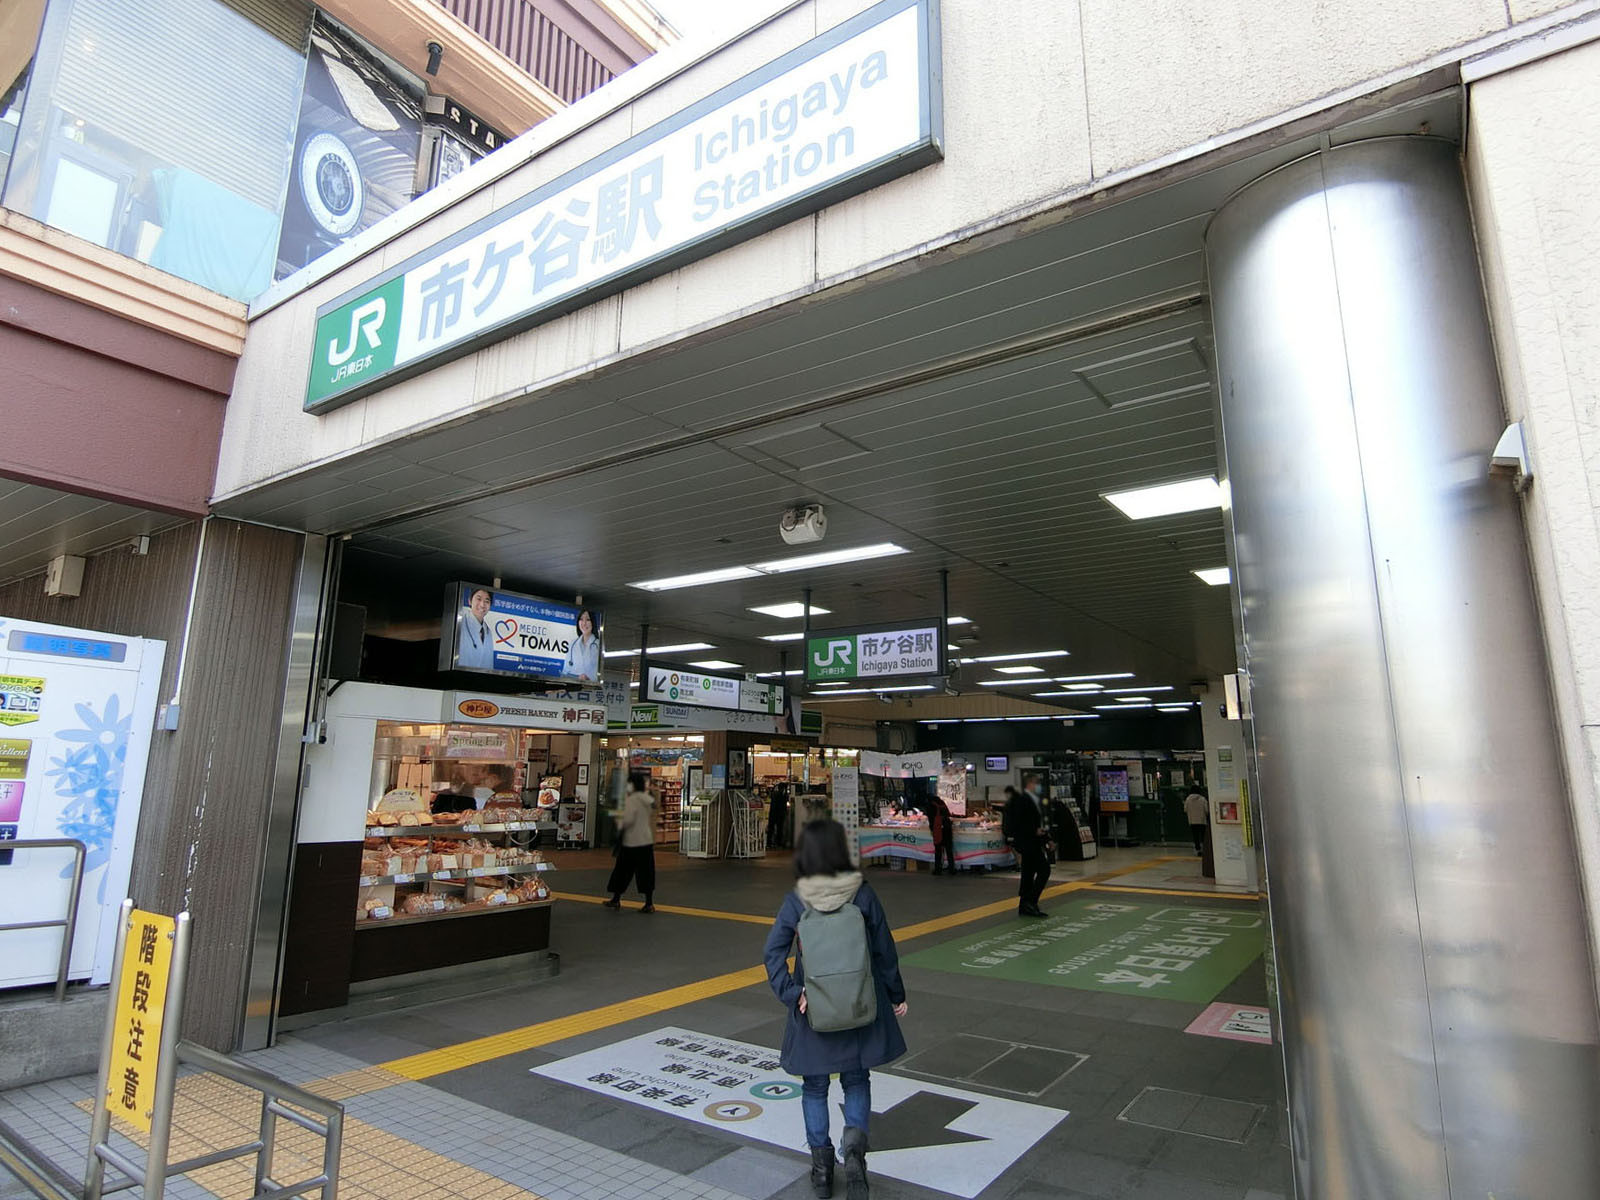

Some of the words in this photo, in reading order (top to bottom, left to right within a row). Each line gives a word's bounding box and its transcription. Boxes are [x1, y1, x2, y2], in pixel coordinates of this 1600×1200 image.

[693, 48, 888, 171] Ichigaya
[450, 107, 504, 149] STA
[693, 126, 855, 223] Station
[328, 297, 386, 366] JR
[331, 354, 374, 383] JR東日本
[519, 623, 547, 636] MEDIC
[519, 634, 569, 653] TOMAS
[814, 640, 852, 667] JR
[817, 667, 846, 676] JR東日本
[861, 660, 898, 673] Ichigaya
[900, 657, 933, 669] Station
[500, 706, 527, 717] FRESH
[528, 709, 559, 719] BAKERY
[452, 736, 483, 747] Spring
[1095, 926, 1231, 988] JR東日本
[121, 923, 159, 1111] 階段注意
[664, 1054, 693, 1063] Line
[611, 1066, 640, 1077] Line
[660, 1063, 745, 1088] 南北線
[695, 1061, 759, 1080] Namboku
[587, 1073, 698, 1108] 有楽町線
[767, 1085, 788, 1096] N
[722, 1106, 739, 1116] Y
